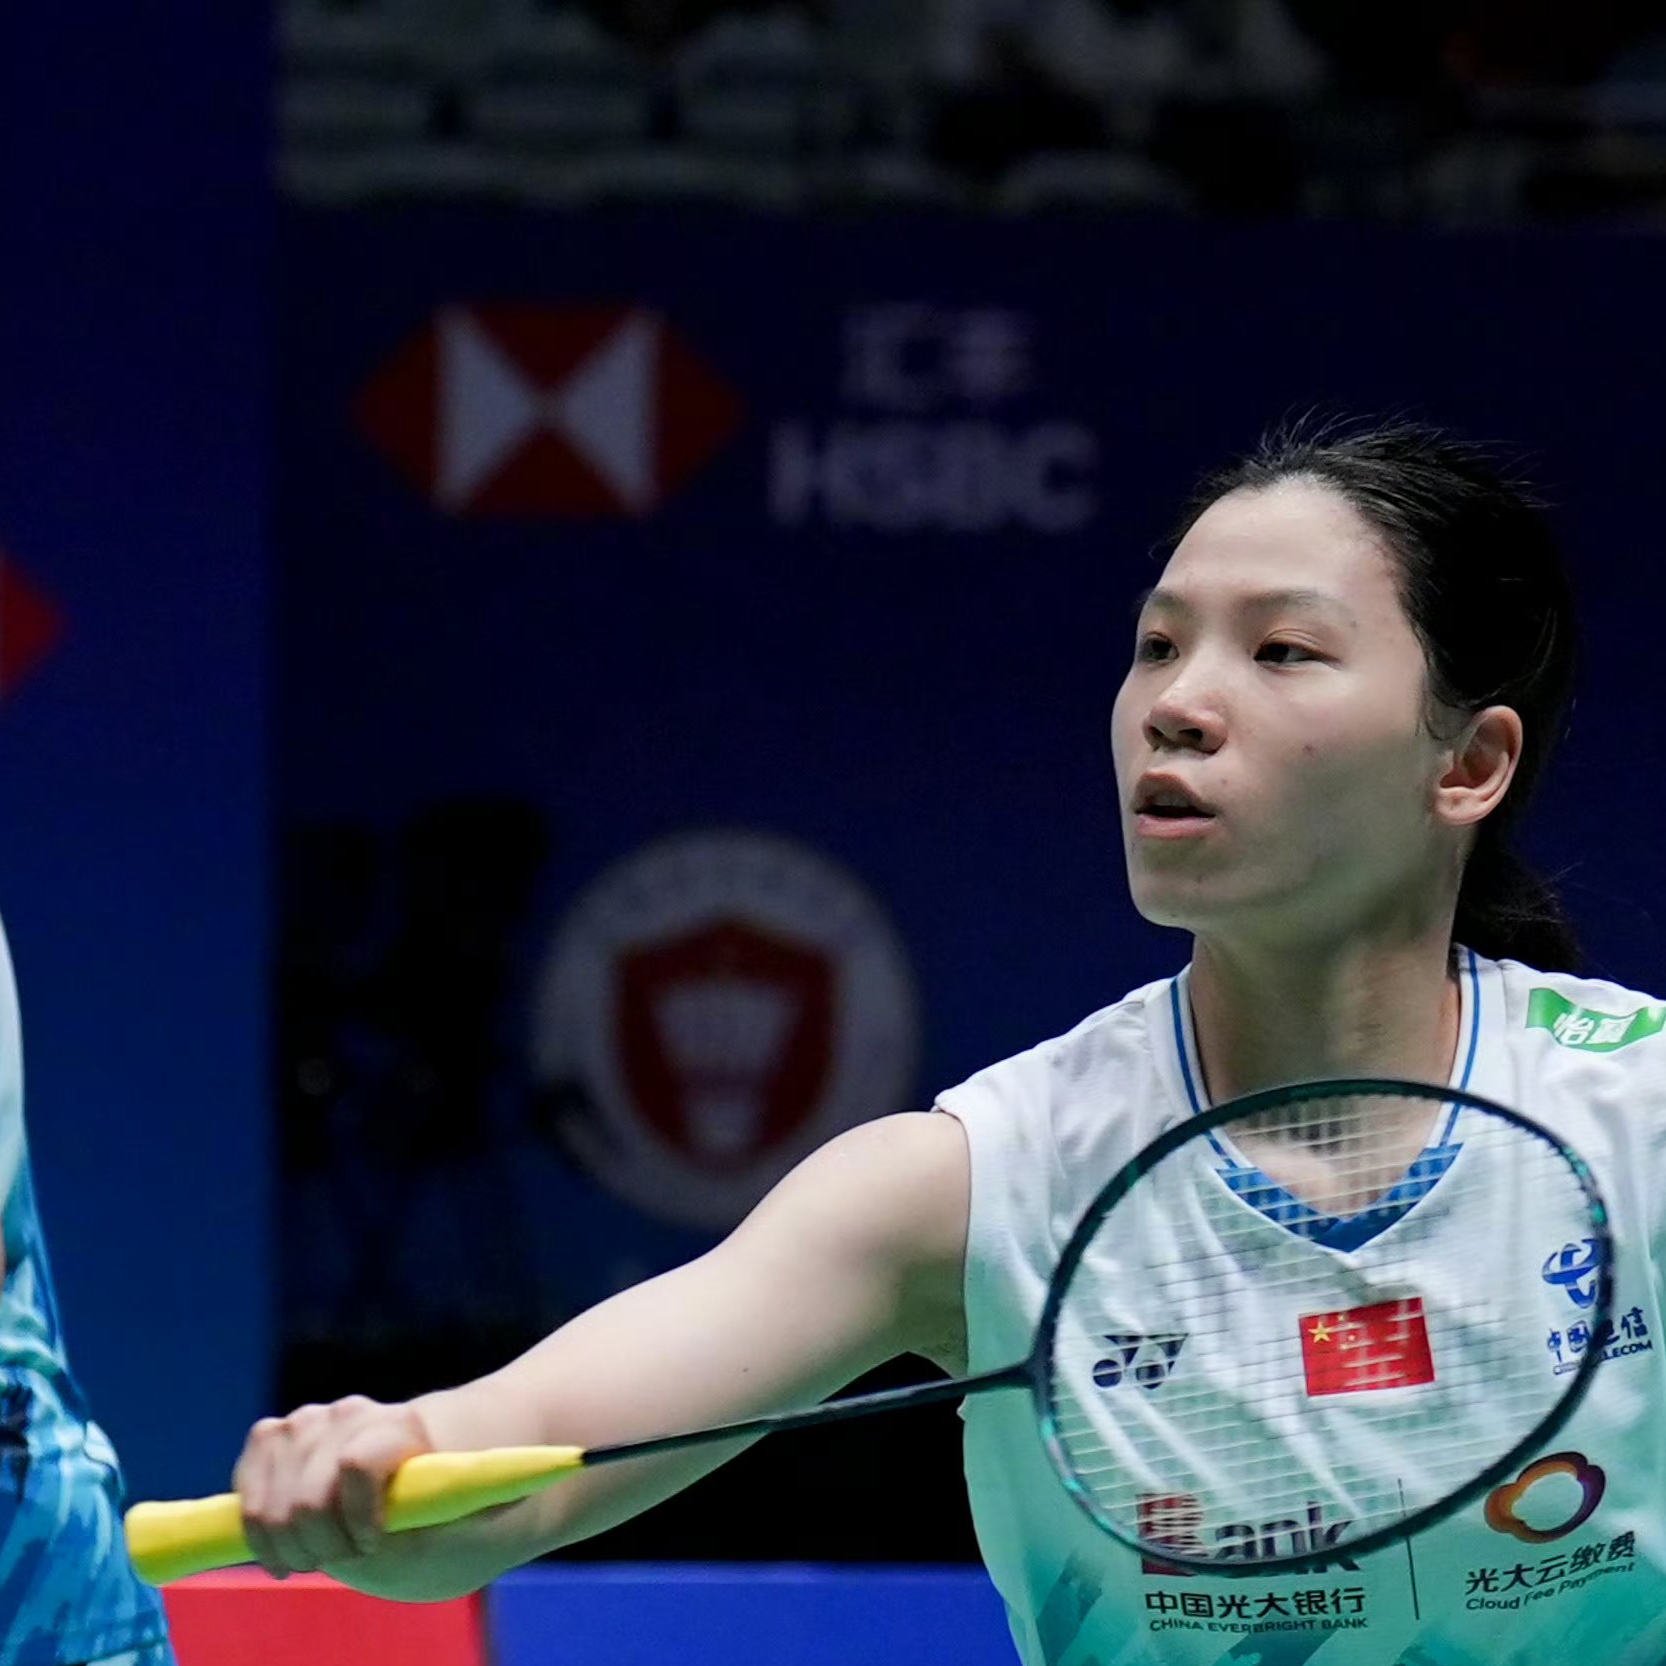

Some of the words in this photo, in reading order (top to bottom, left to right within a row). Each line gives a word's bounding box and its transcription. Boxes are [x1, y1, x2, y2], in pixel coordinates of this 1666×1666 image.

[1465, 1530, 1636, 1596] 光大云缴费
[1145, 1586, 1367, 1620] 中国光大银行
[1466, 1597, 1521, 1610] Cloud
[1523, 1586, 1555, 1606] Fee
[1558, 1562, 1636, 1595] Payment
[1149, 1618, 1203, 1632] CHINA
[1207, 1619, 1316, 1634] EVERBRIGHT
[1321, 1617, 1369, 1631] BANK
